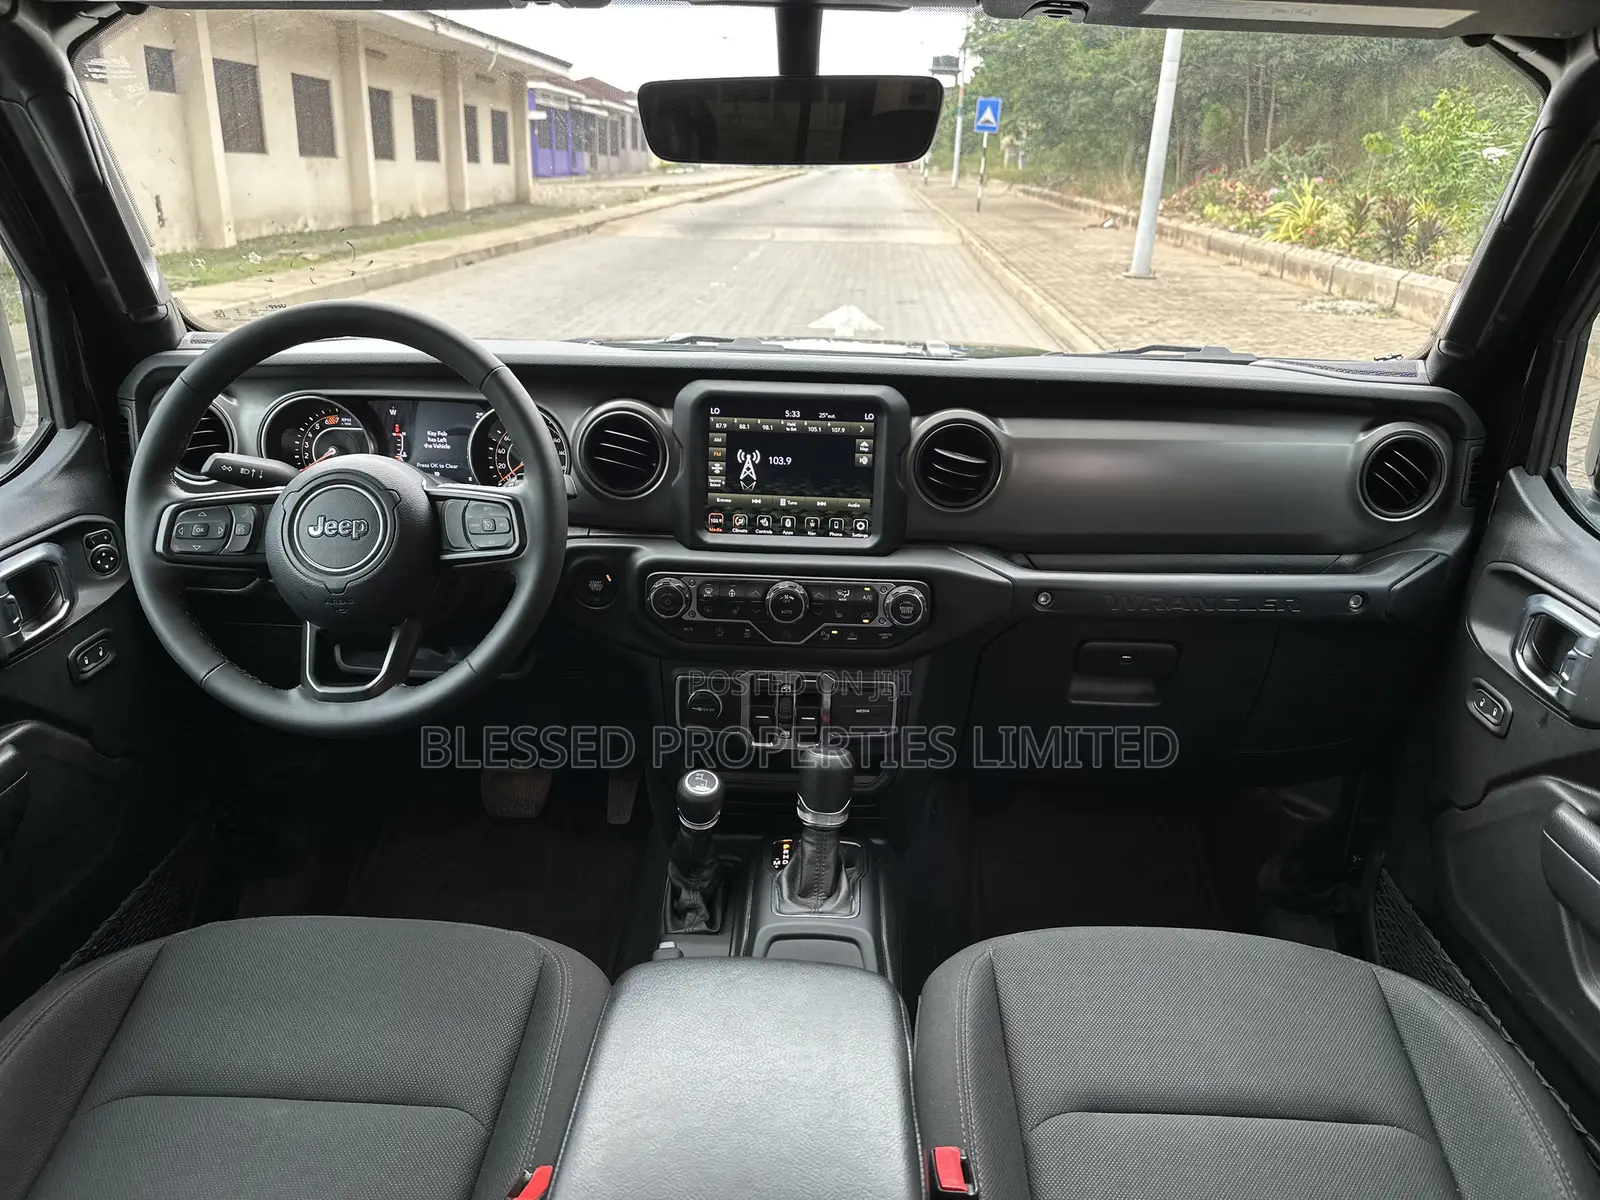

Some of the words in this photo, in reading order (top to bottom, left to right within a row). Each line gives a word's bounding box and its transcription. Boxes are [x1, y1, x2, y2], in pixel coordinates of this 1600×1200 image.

[710, 407, 721, 415] LO
[785, 410, 801, 418] 5:33
[304, 441, 309, 449] 3
[768, 456, 792, 465] 103.9
[308, 515, 368, 540] Jeep
[1103, 593, 1302, 613] WRANGLER
